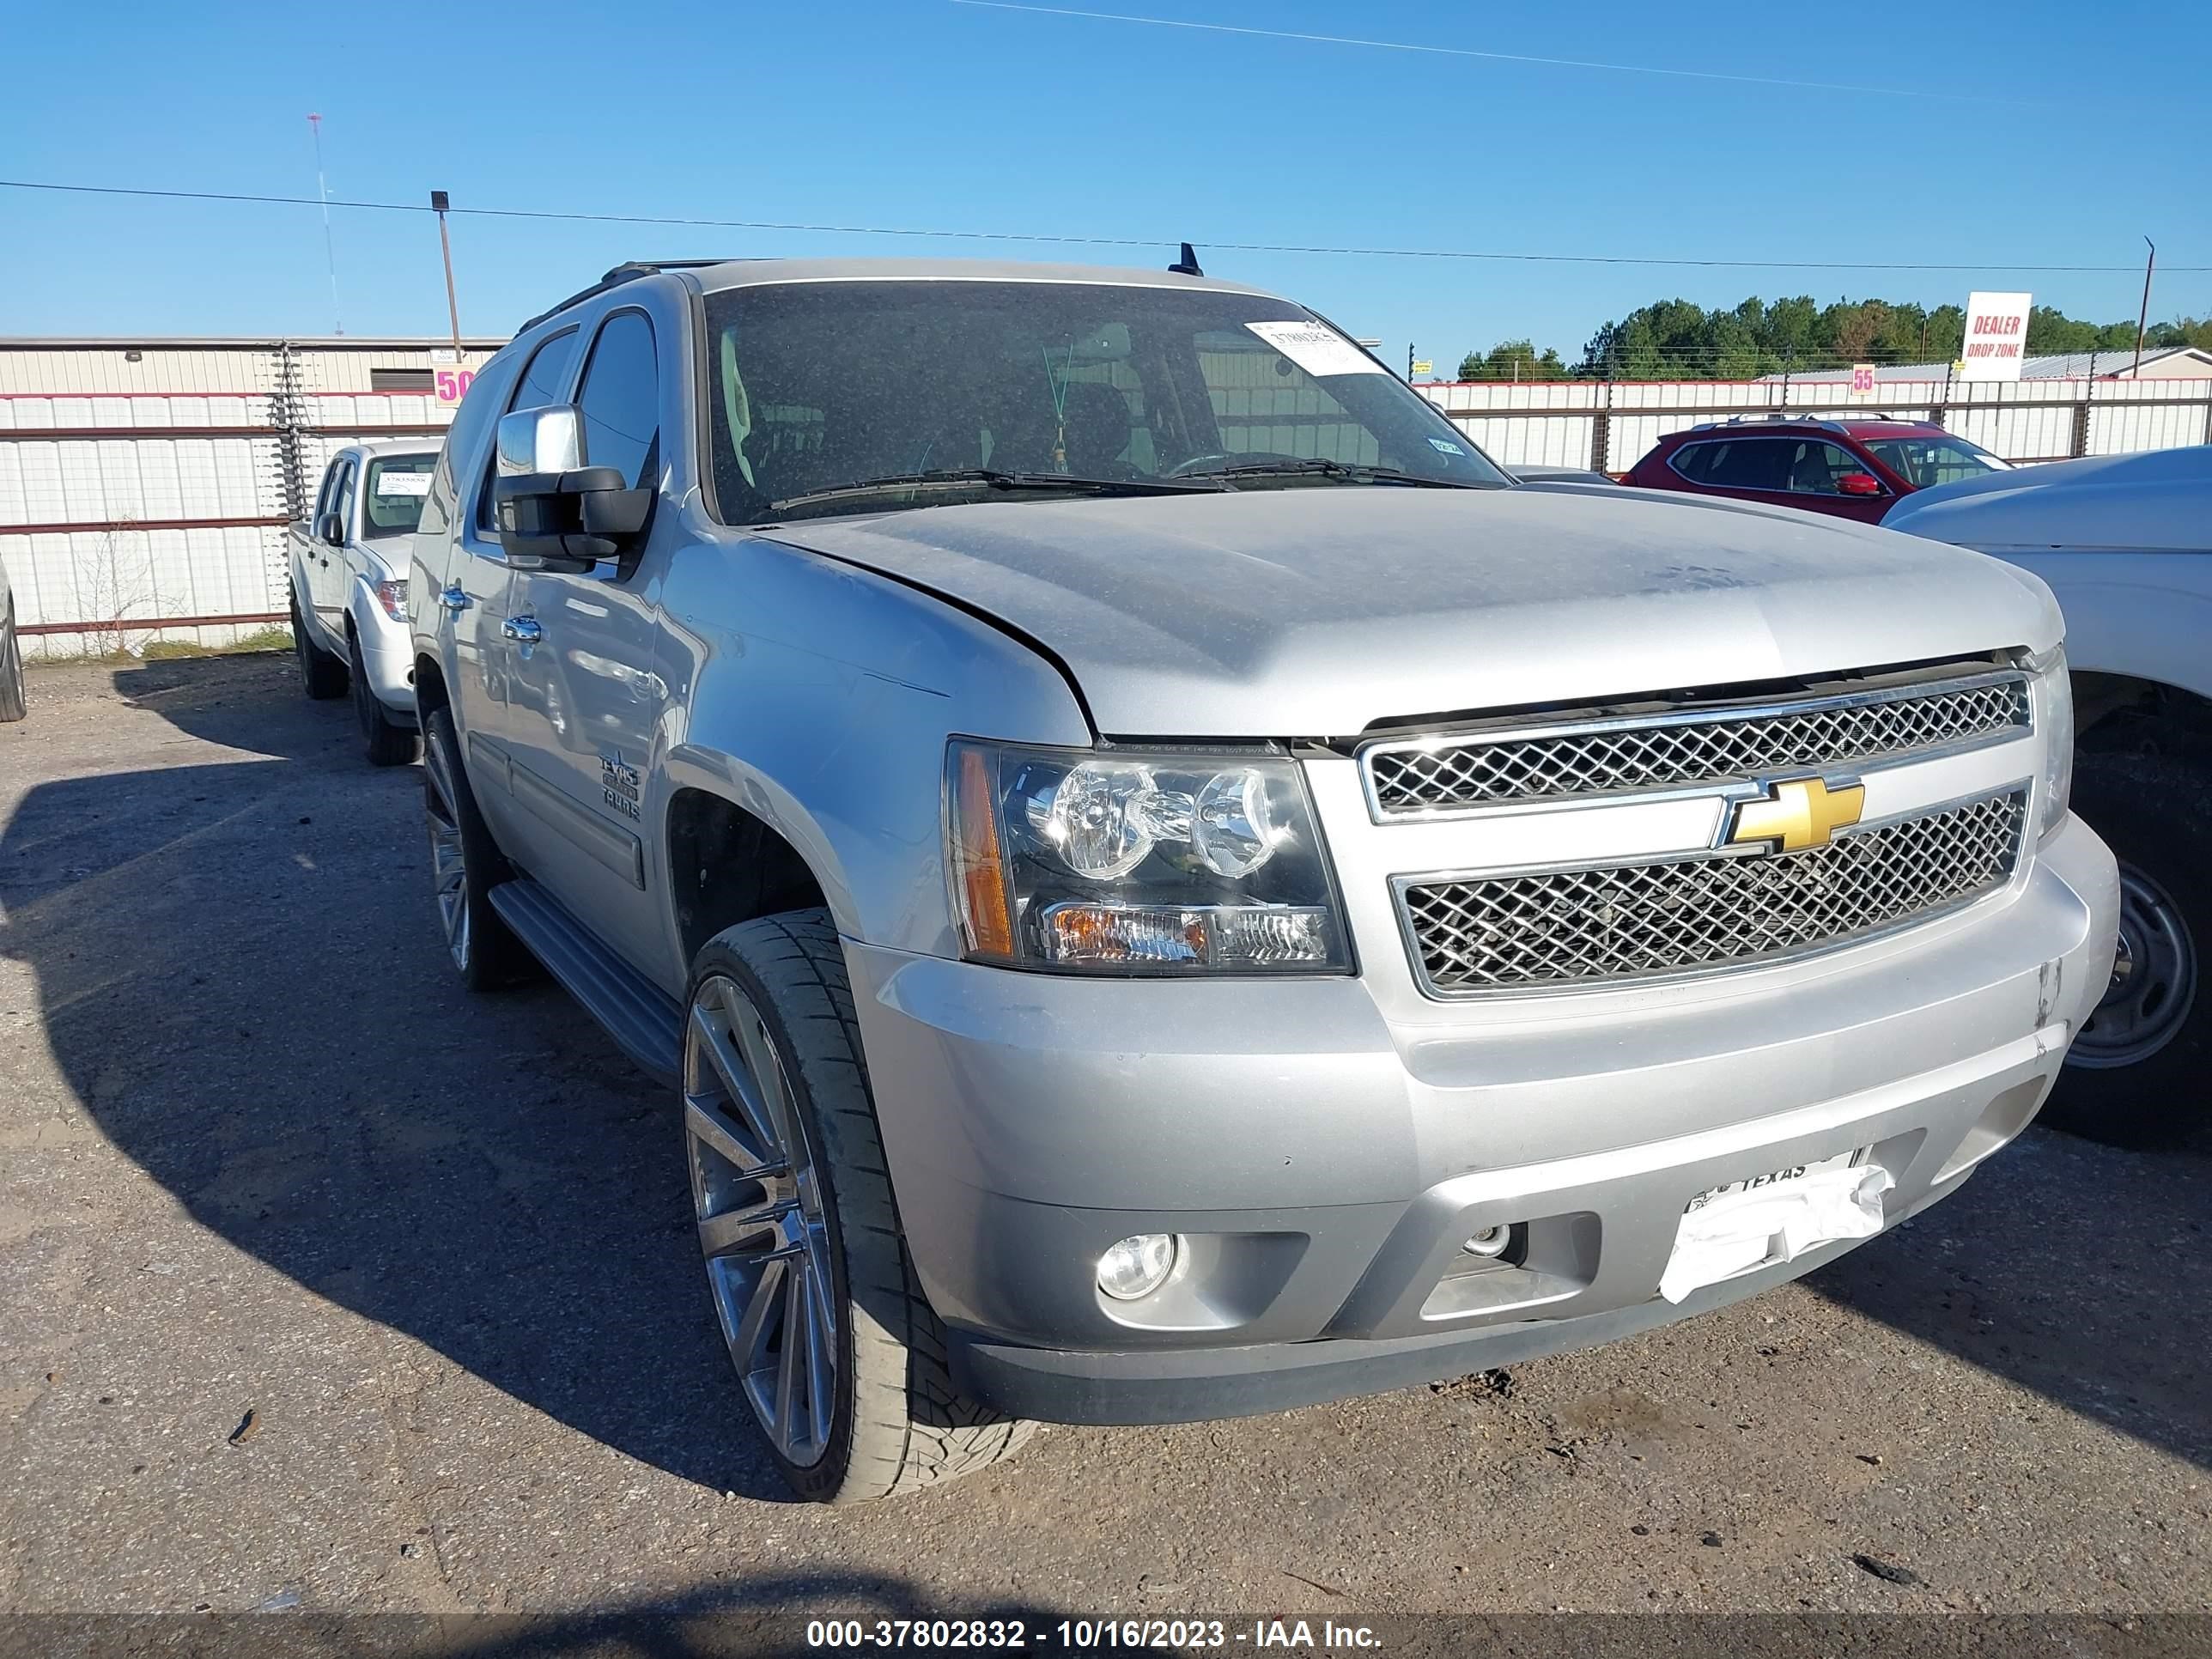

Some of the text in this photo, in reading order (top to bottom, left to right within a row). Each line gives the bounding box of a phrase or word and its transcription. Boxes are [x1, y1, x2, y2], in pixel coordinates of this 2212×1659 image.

[1973, 316, 2021, 335] DEALER
[1967, 343, 2021, 357] DROP ZONE
[1854, 369, 1873, 390] 55
[1742, 1166, 1807, 1192] TEXAS
